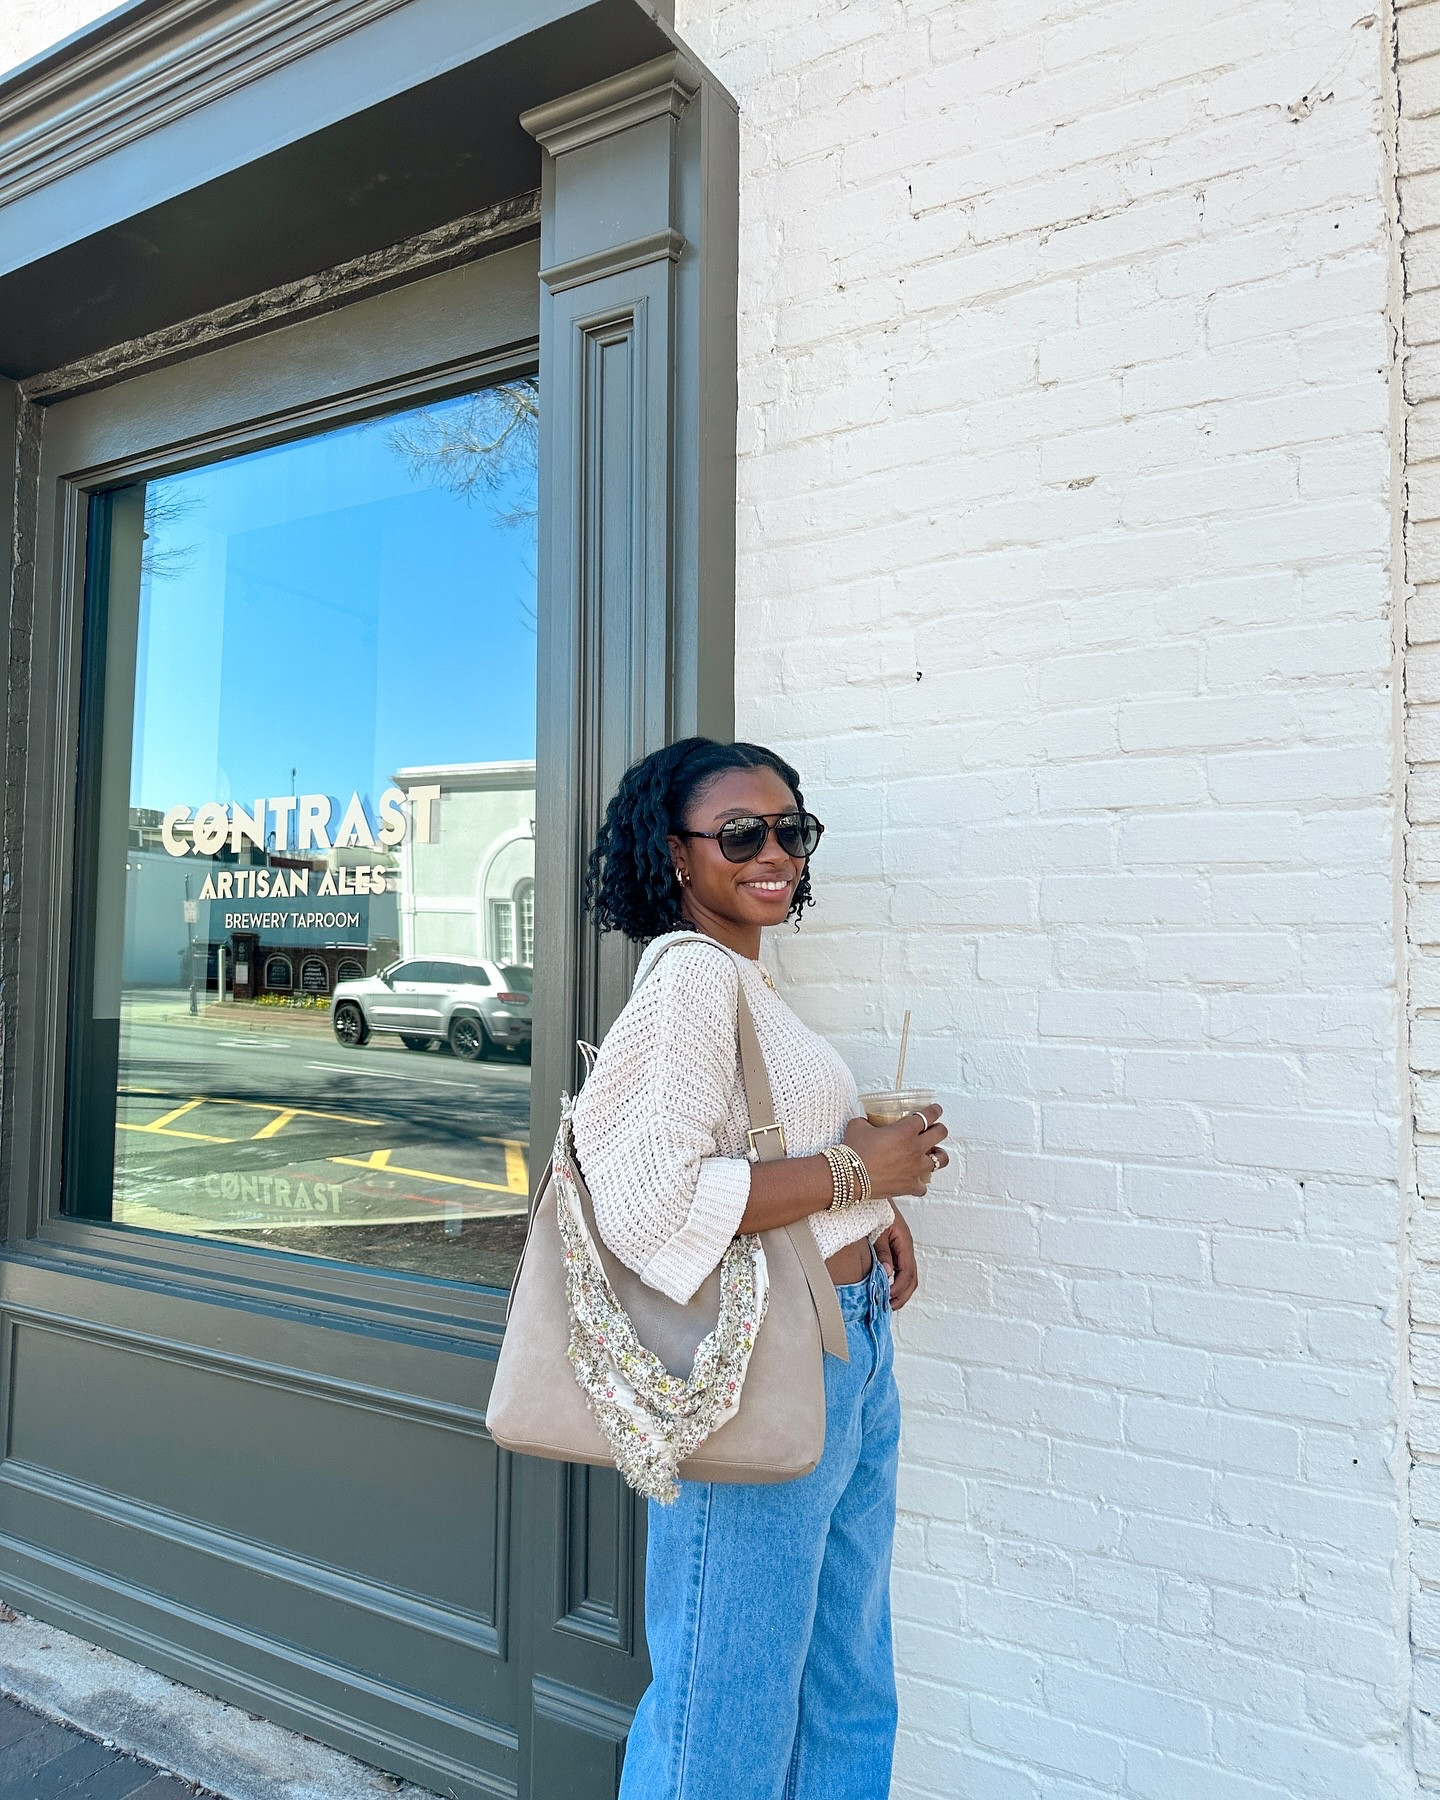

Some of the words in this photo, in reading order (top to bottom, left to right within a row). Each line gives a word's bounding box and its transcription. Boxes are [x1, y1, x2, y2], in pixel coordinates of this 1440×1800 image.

[199, 868, 308, 900] ARTISAN
[317, 865, 387, 896] ALES
[225, 913, 287, 929] BREWERY
[290, 912, 359, 928] TAPROOM
